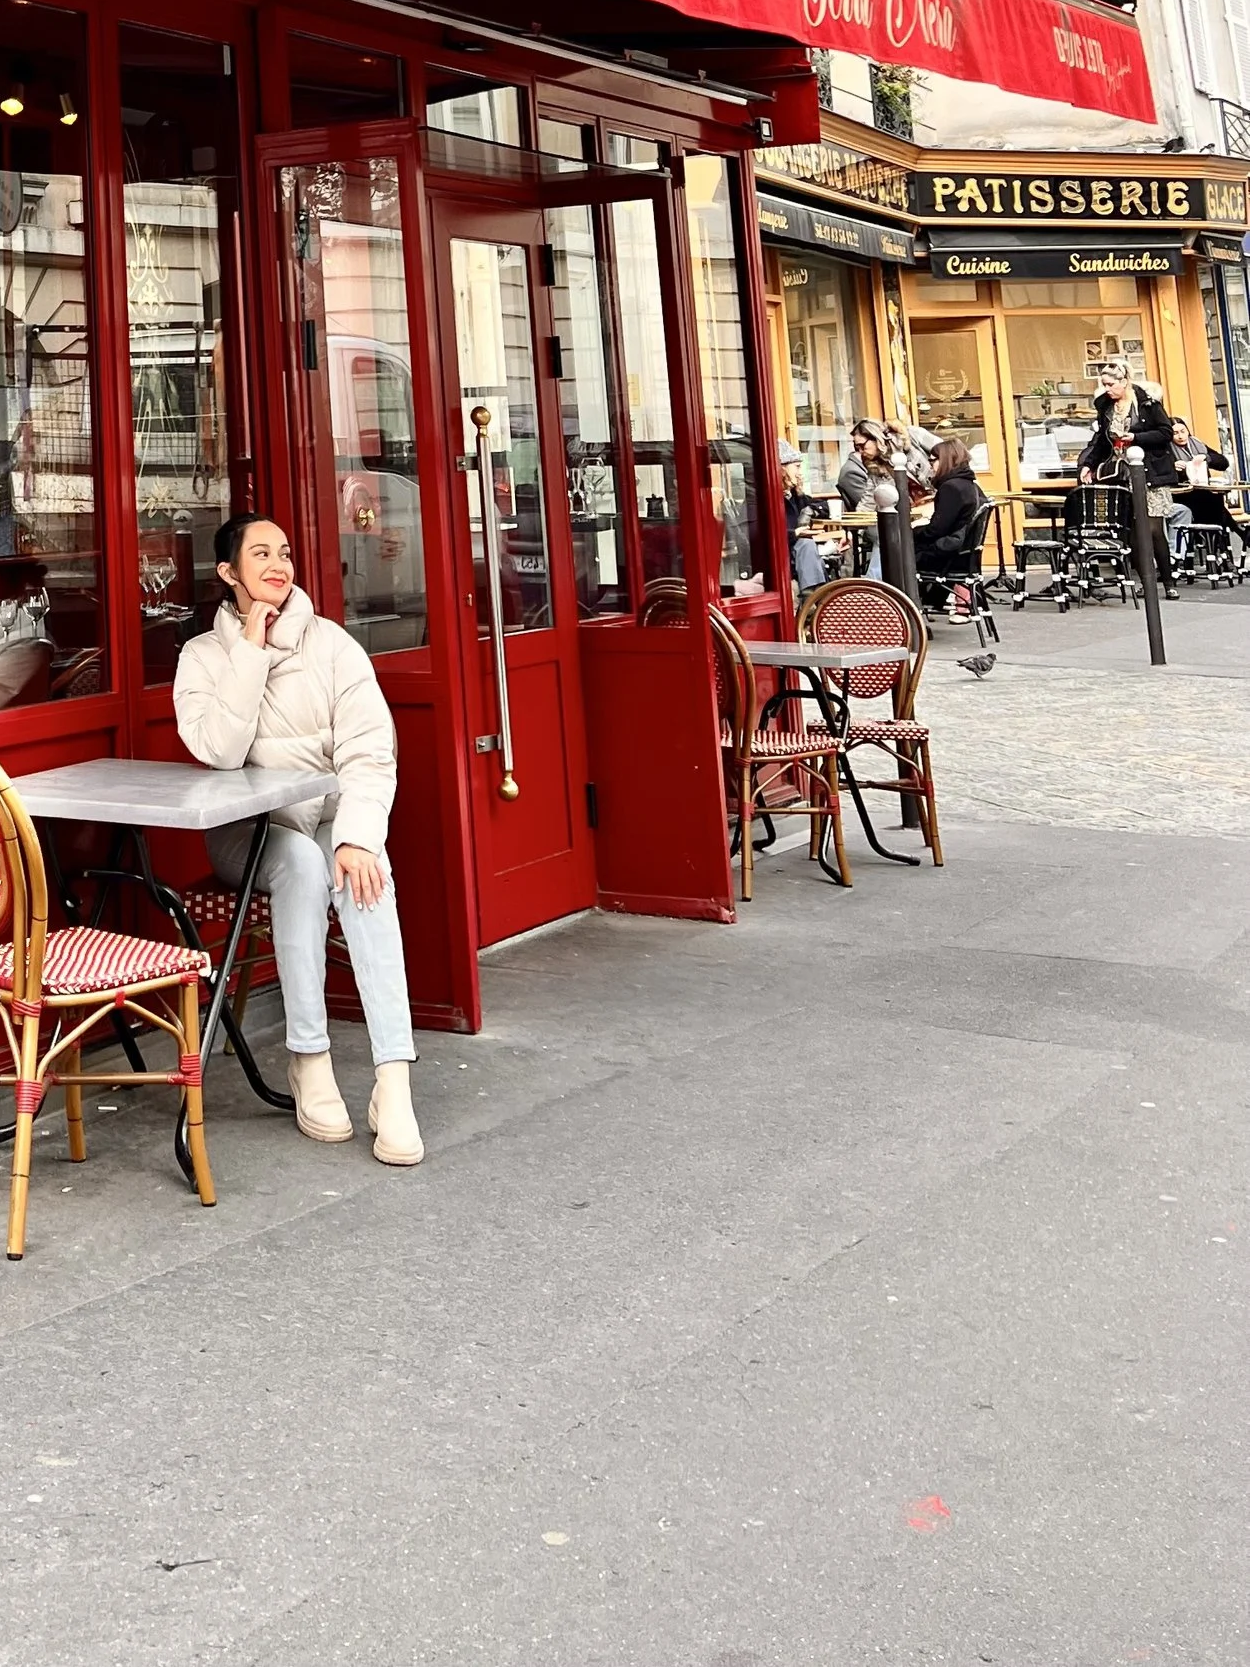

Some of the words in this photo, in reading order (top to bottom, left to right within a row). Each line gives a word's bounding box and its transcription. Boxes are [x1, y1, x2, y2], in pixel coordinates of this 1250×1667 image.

[932, 177, 1190, 216] PATISSERIE
[946, 255, 1012, 275] Cuisine
[1068, 251, 1170, 273] Sandwiches
